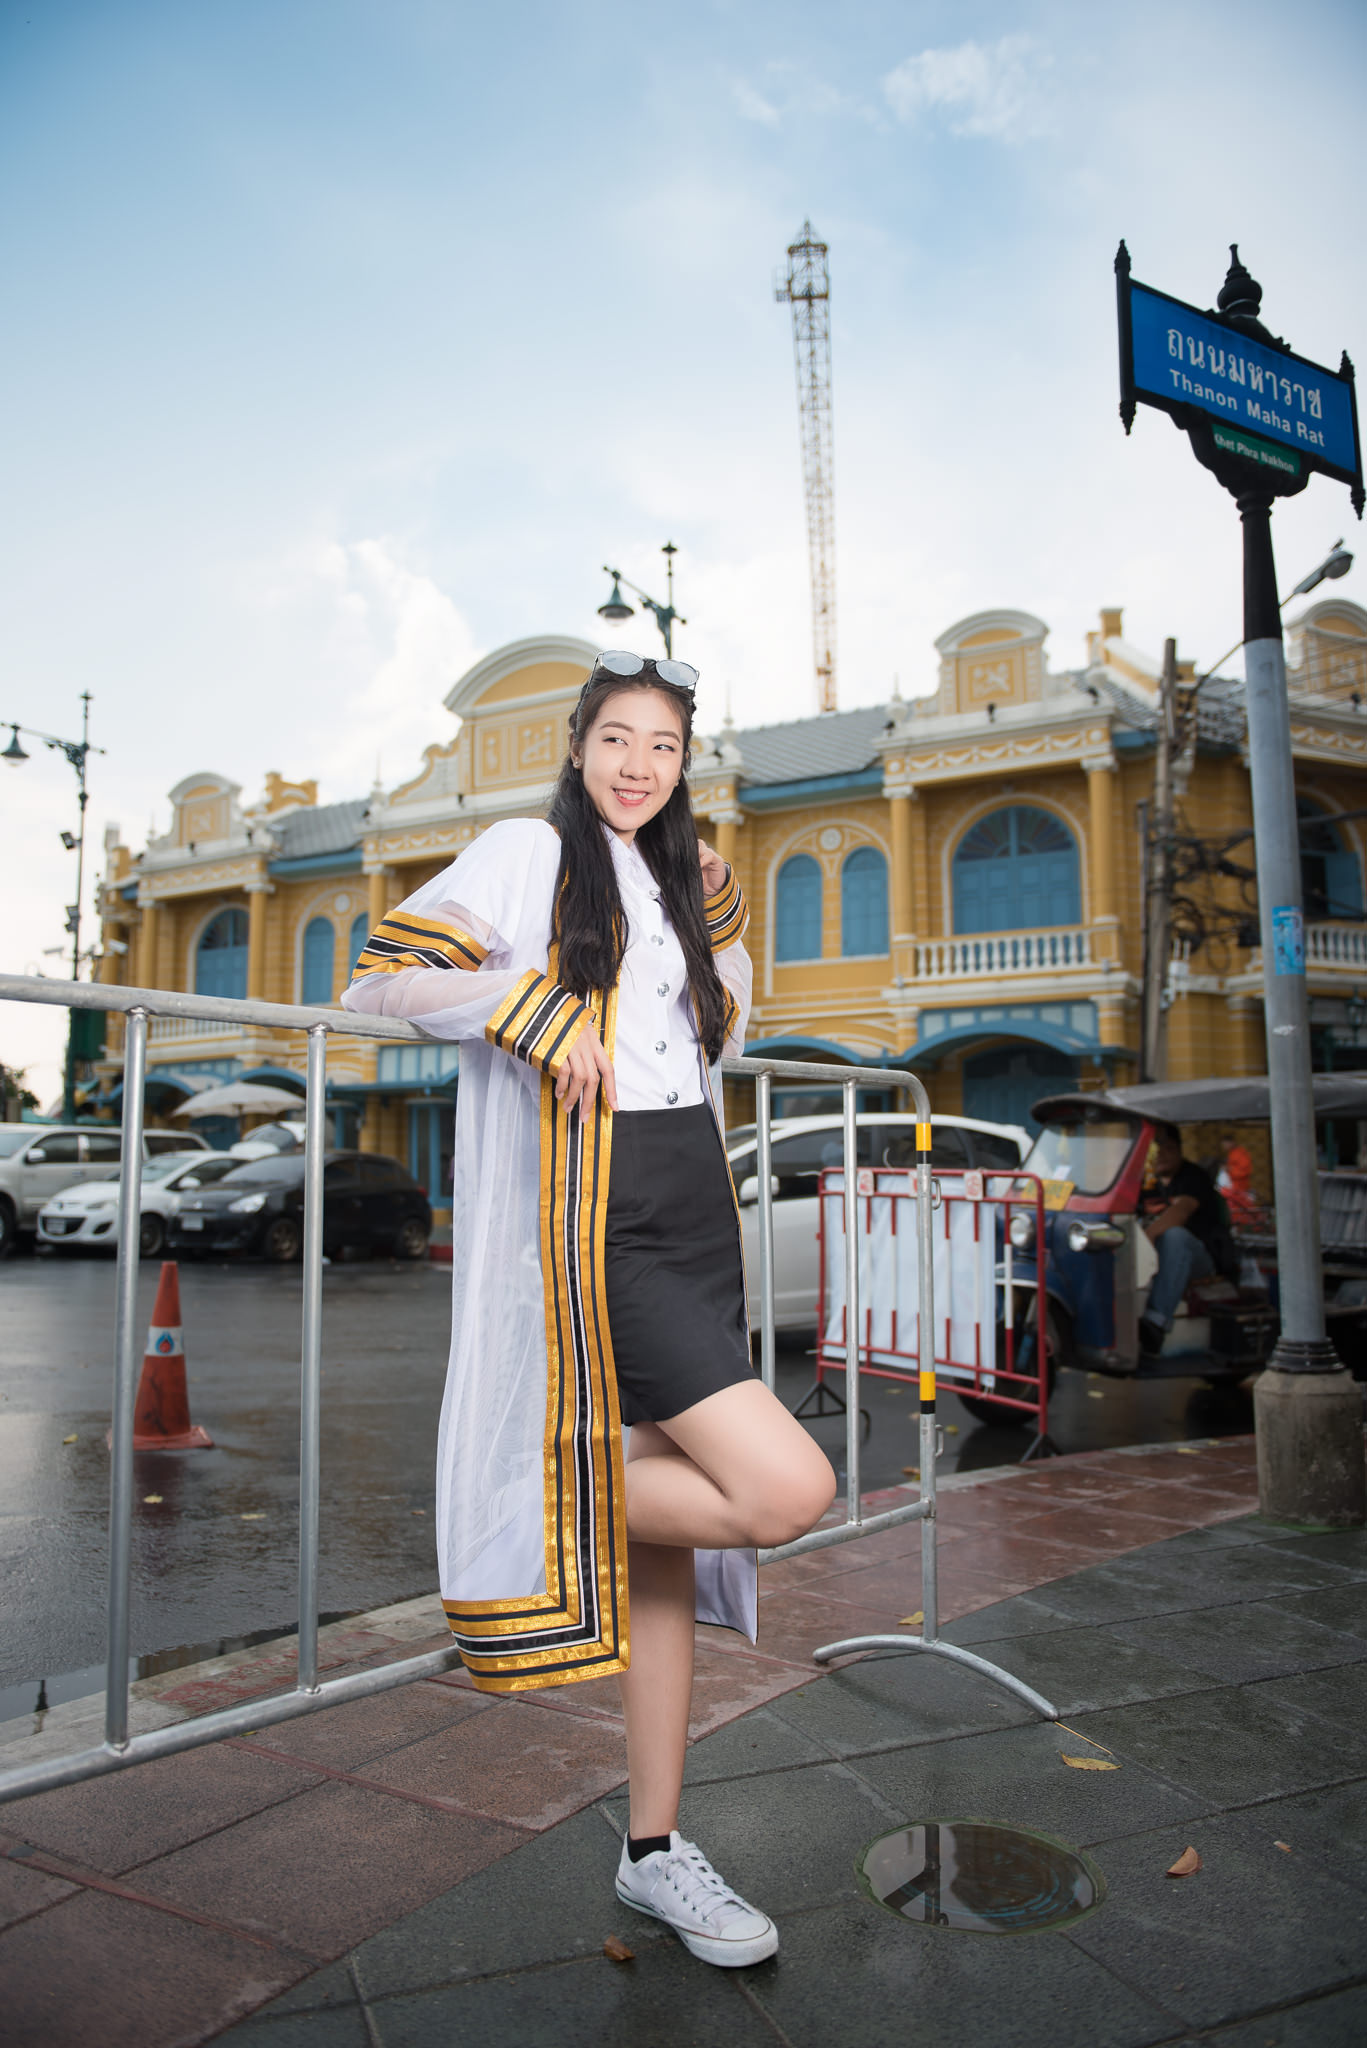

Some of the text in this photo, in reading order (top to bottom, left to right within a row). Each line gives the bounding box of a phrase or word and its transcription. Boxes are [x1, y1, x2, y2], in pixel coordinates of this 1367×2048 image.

[1167, 328, 1322, 419] ถนนมหาราช
[1170, 368, 1325, 447] Thanon Maha Rat
